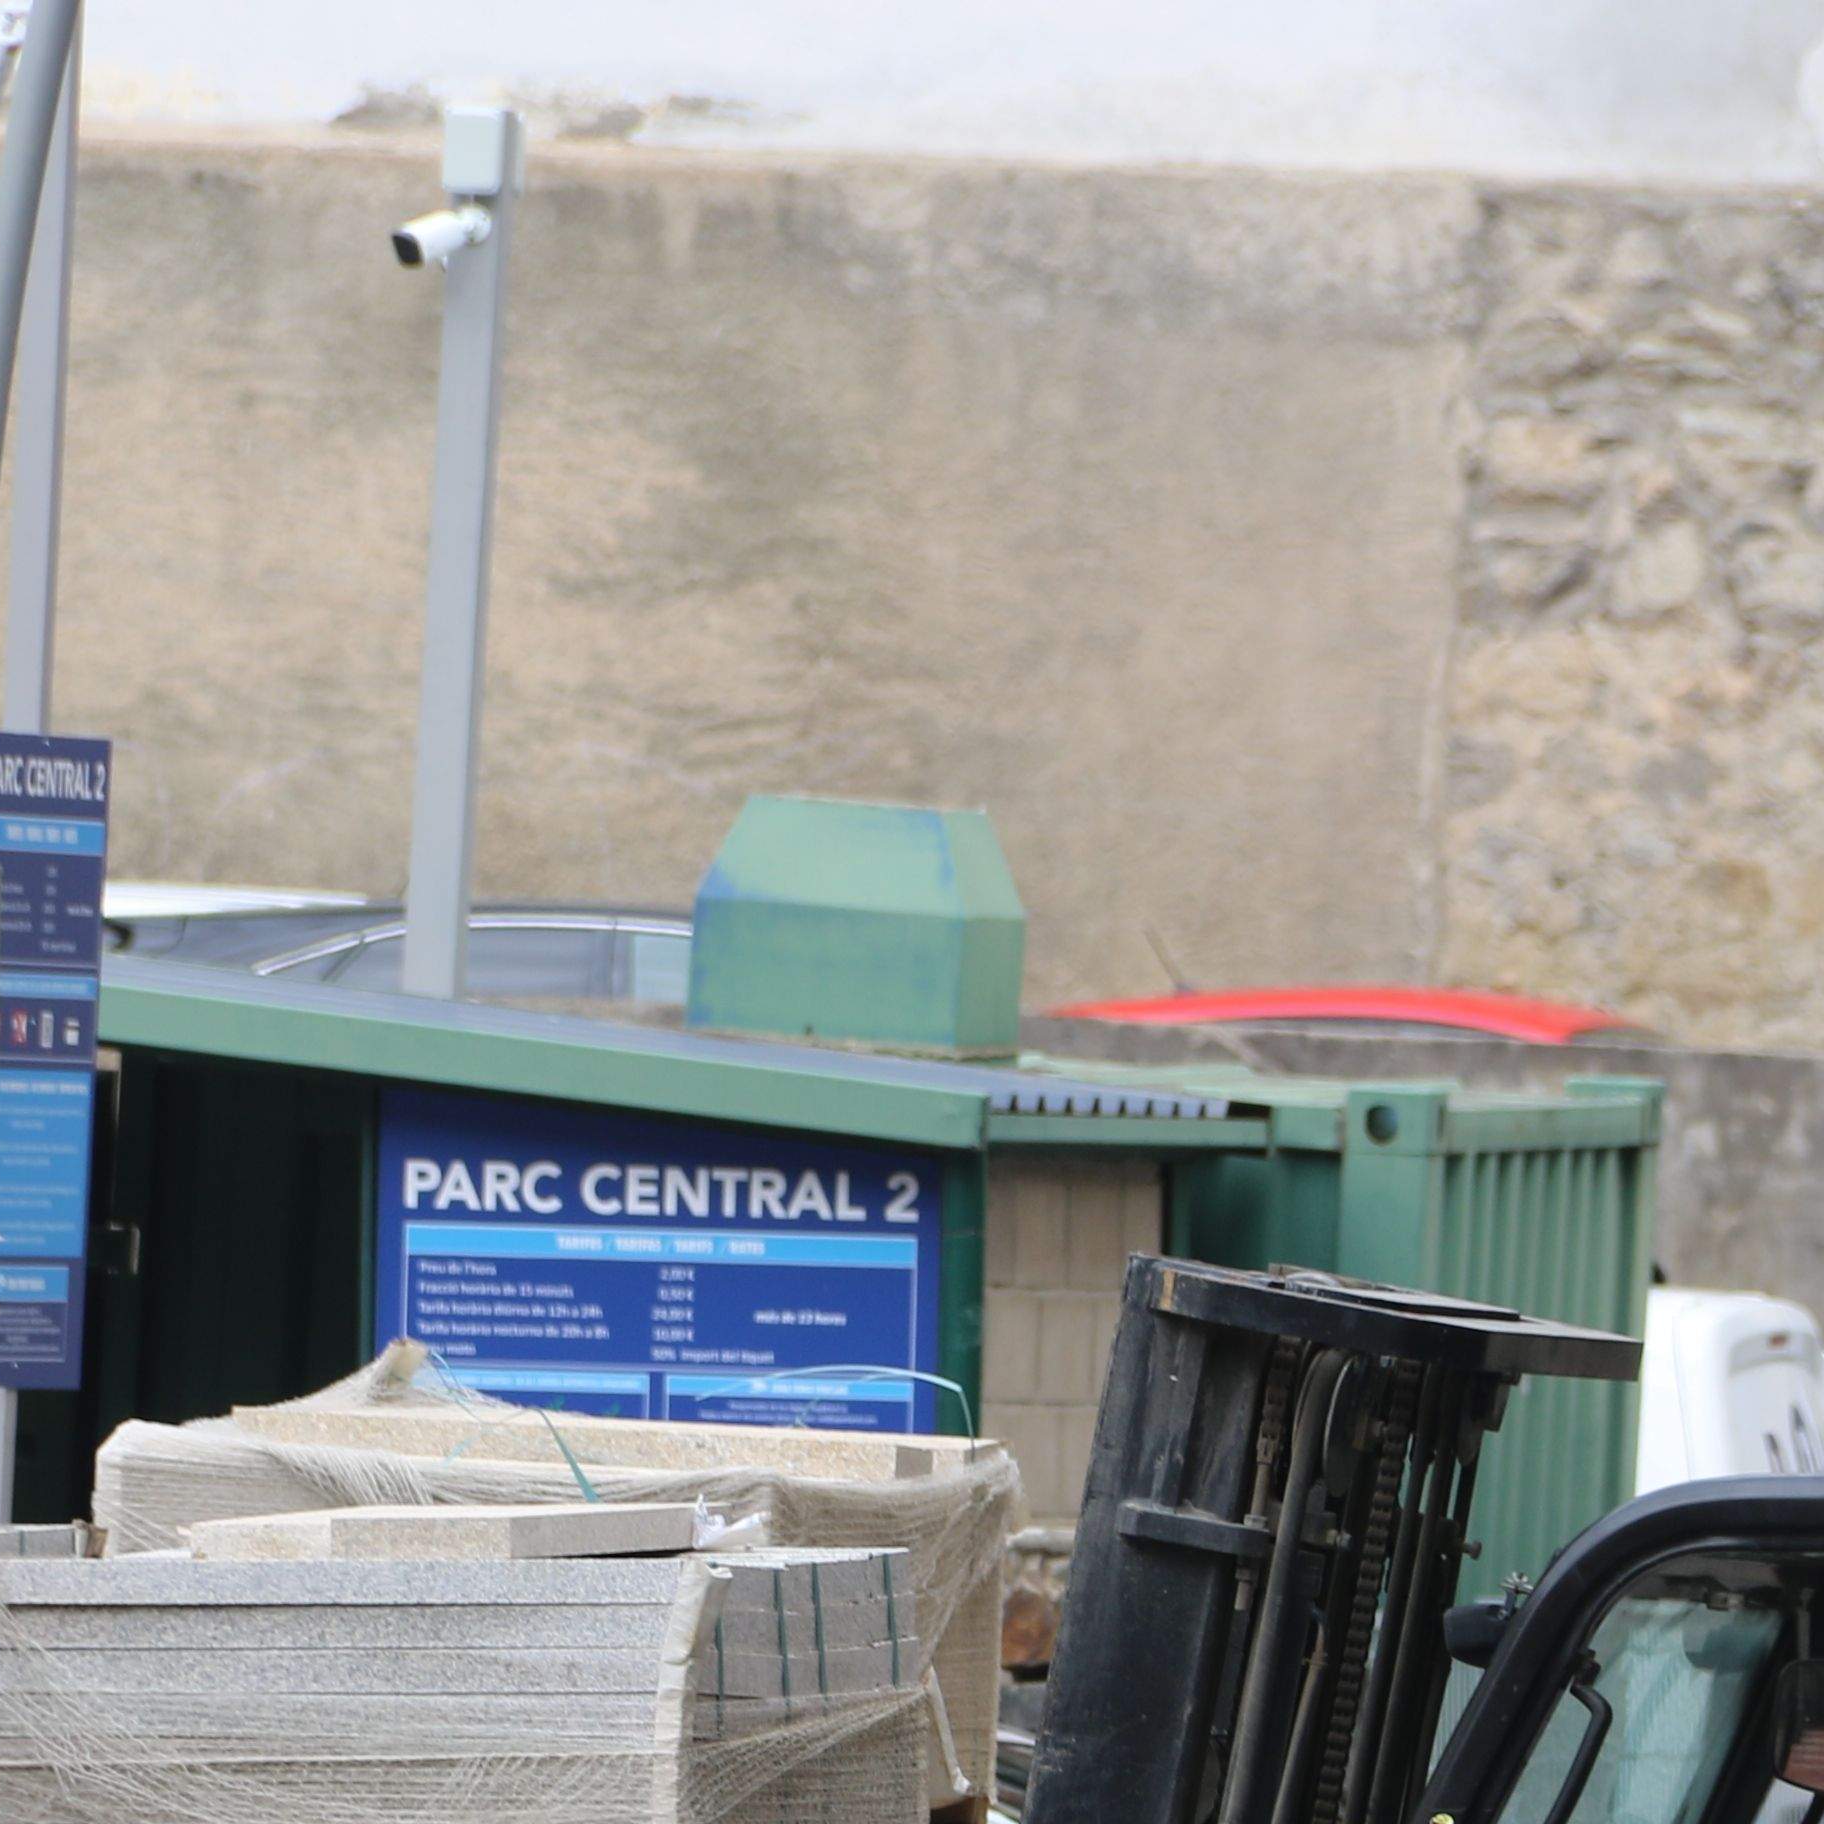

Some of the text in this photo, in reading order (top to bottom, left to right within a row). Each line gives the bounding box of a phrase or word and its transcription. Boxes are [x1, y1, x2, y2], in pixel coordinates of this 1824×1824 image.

[27, 758, 93, 800] CENTRAL
[95, 761, 107, 802] 2
[404, 1157, 921, 1223] PARC CENTRAL 2
